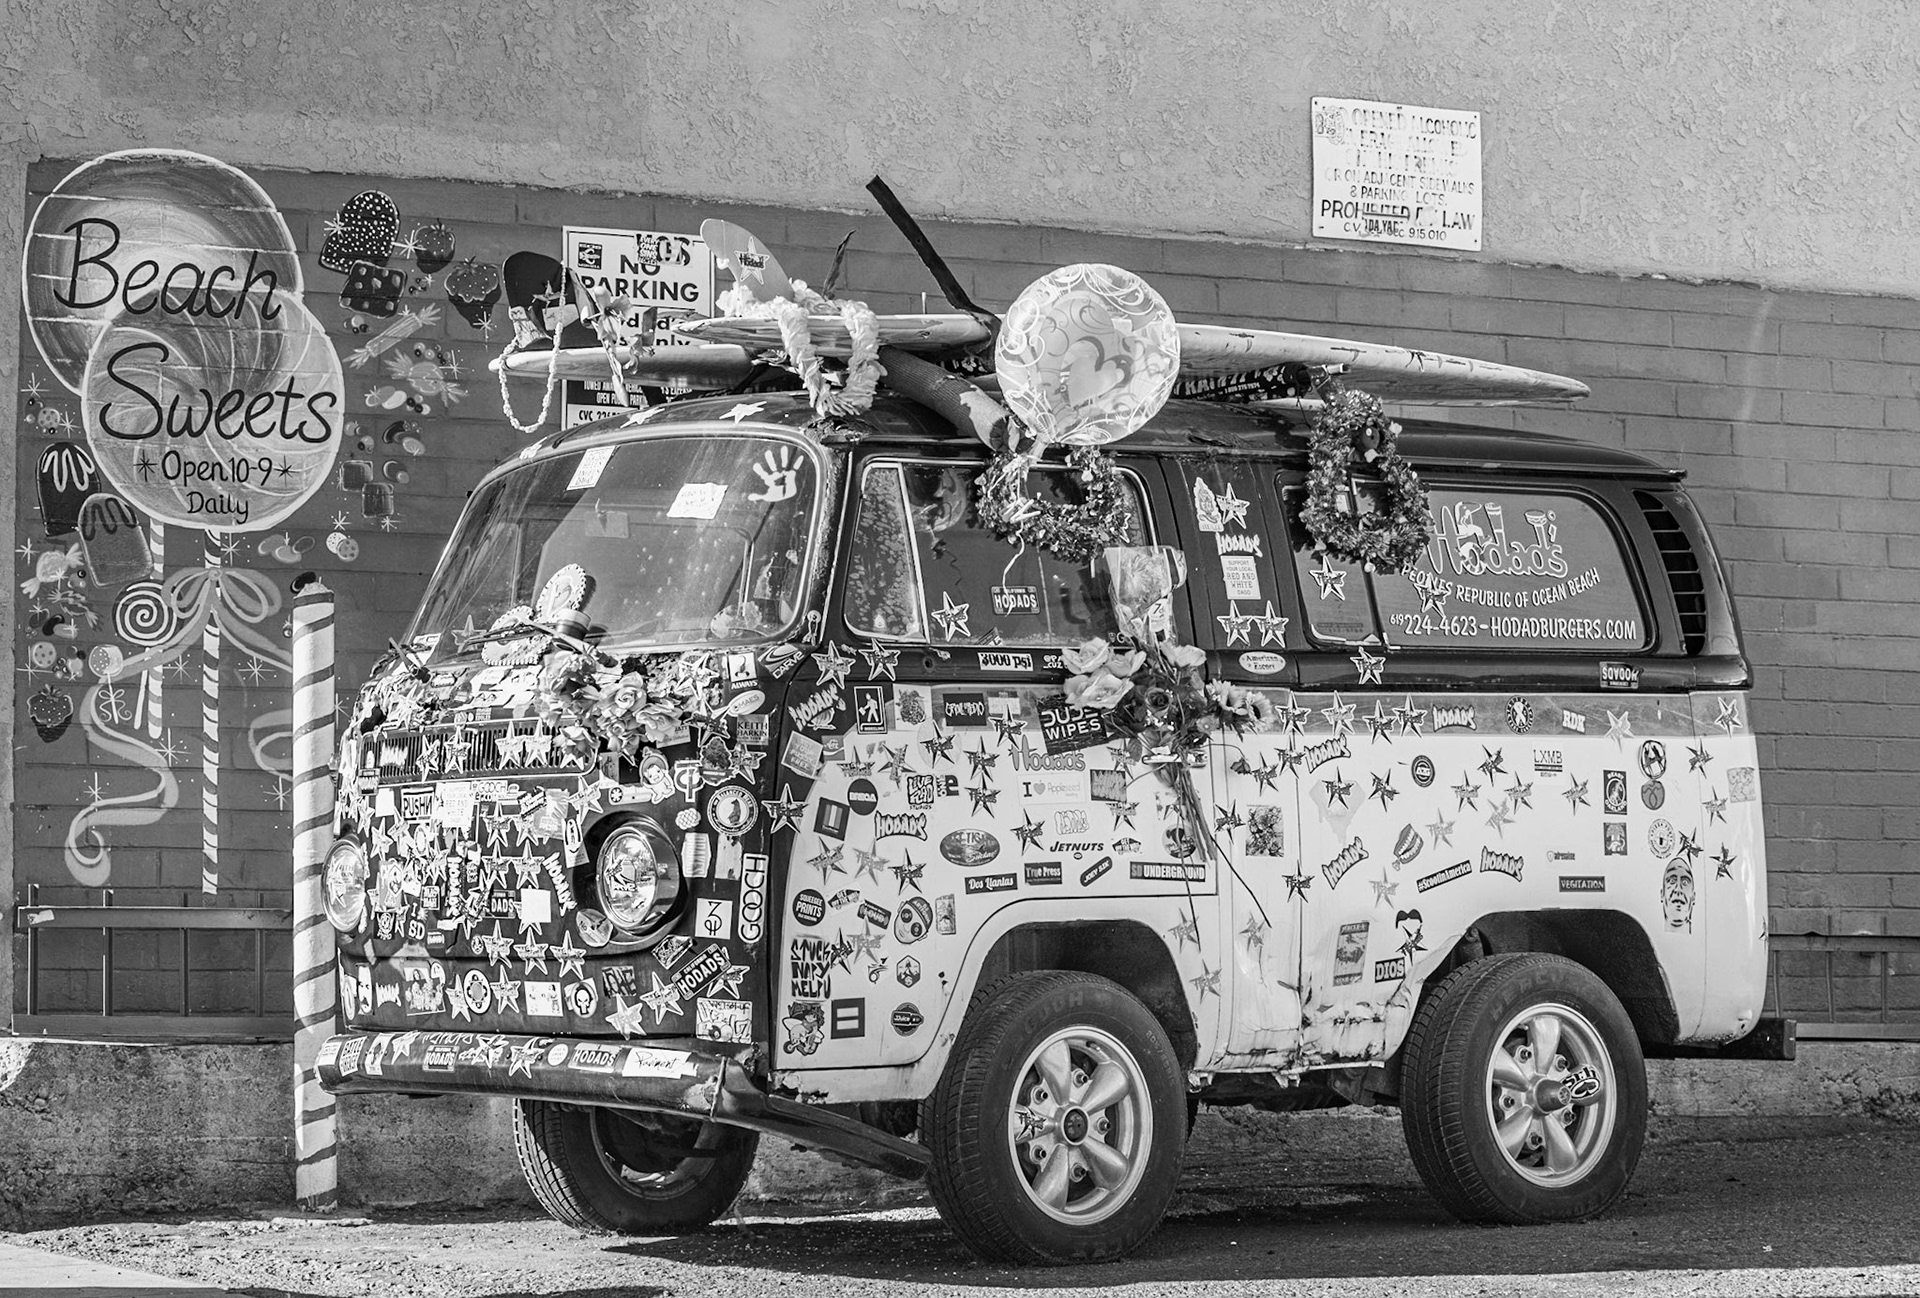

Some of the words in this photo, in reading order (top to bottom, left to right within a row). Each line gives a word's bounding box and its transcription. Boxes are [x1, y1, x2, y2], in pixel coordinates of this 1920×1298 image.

[53, 217, 282, 320] Beach
[581, 275, 700, 303] PARKING
[99, 342, 338, 443] Sweets
[161, 450, 228, 486] Open
[228, 457, 274, 484] 10-9
[186, 492, 250, 524] Daily
[1226, 572, 1240, 581] RED
[1241, 572, 1256, 581] AND
[1231, 580, 1253, 589] WHITE
[1456, 584, 1512, 608] REPUBLIC
[1514, 592, 1529, 608] OF
[1532, 583, 1567, 607] OCEAN
[1568, 567, 1601, 597] BEACH
[994, 594, 1038, 609] HODADS
[1390, 614, 1404, 626] 619
[981, 653, 1012, 667] 3000
[1045, 718, 1101, 740] WIPES
[1533, 749, 1563, 764] LXMB
[1022, 782, 1033, 798] I
[1049, 841, 1105, 853] JETNUTS
[1042, 866, 1061, 877] Press
[1143, 864, 1205, 880] UNDERGROUND
[968, 878, 984, 890] Dos
[1560, 879, 1604, 889] VEGITATION
[741, 856, 767, 941] GOOCH
[795, 900, 823, 918] PRINTS
[677, 952, 725, 995] HODADS
[1375, 959, 1405, 981] DIOS
[572, 1049, 616, 1067] HODADS
